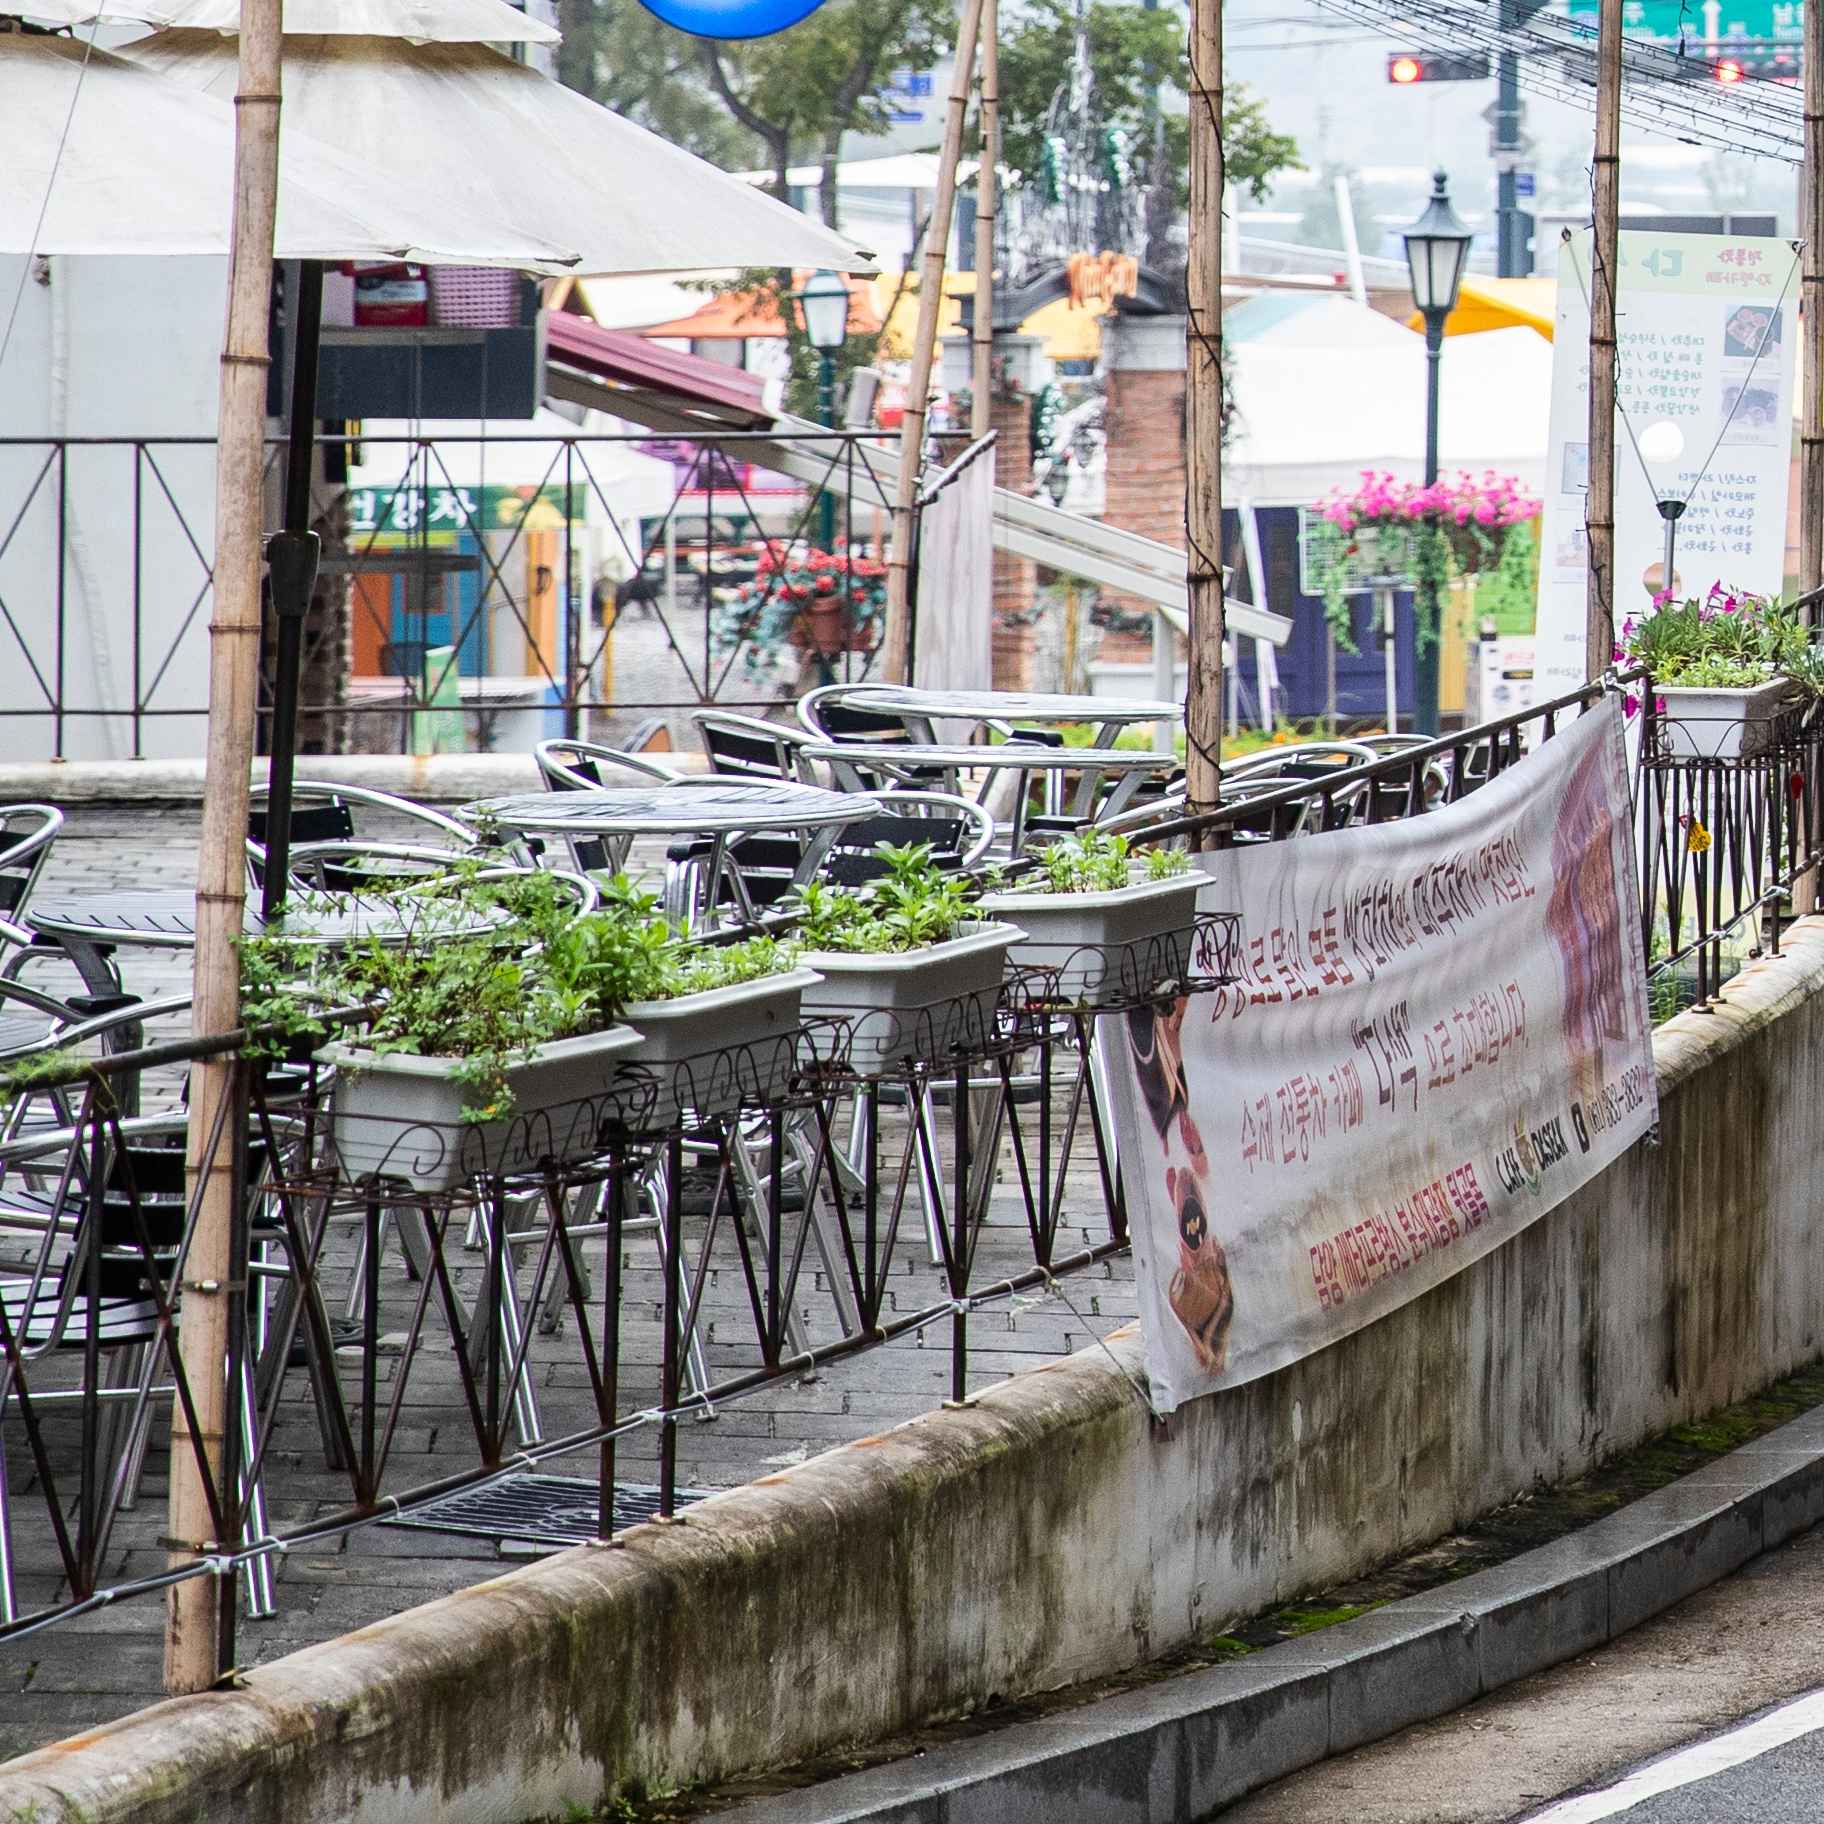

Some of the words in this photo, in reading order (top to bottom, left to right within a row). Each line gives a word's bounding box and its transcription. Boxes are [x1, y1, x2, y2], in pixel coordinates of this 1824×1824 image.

[1240, 1092, 1275, 1174] 수제
[1275, 1072, 1328, 1164] 전통차
[1327, 1057, 1364, 1135] 카페
